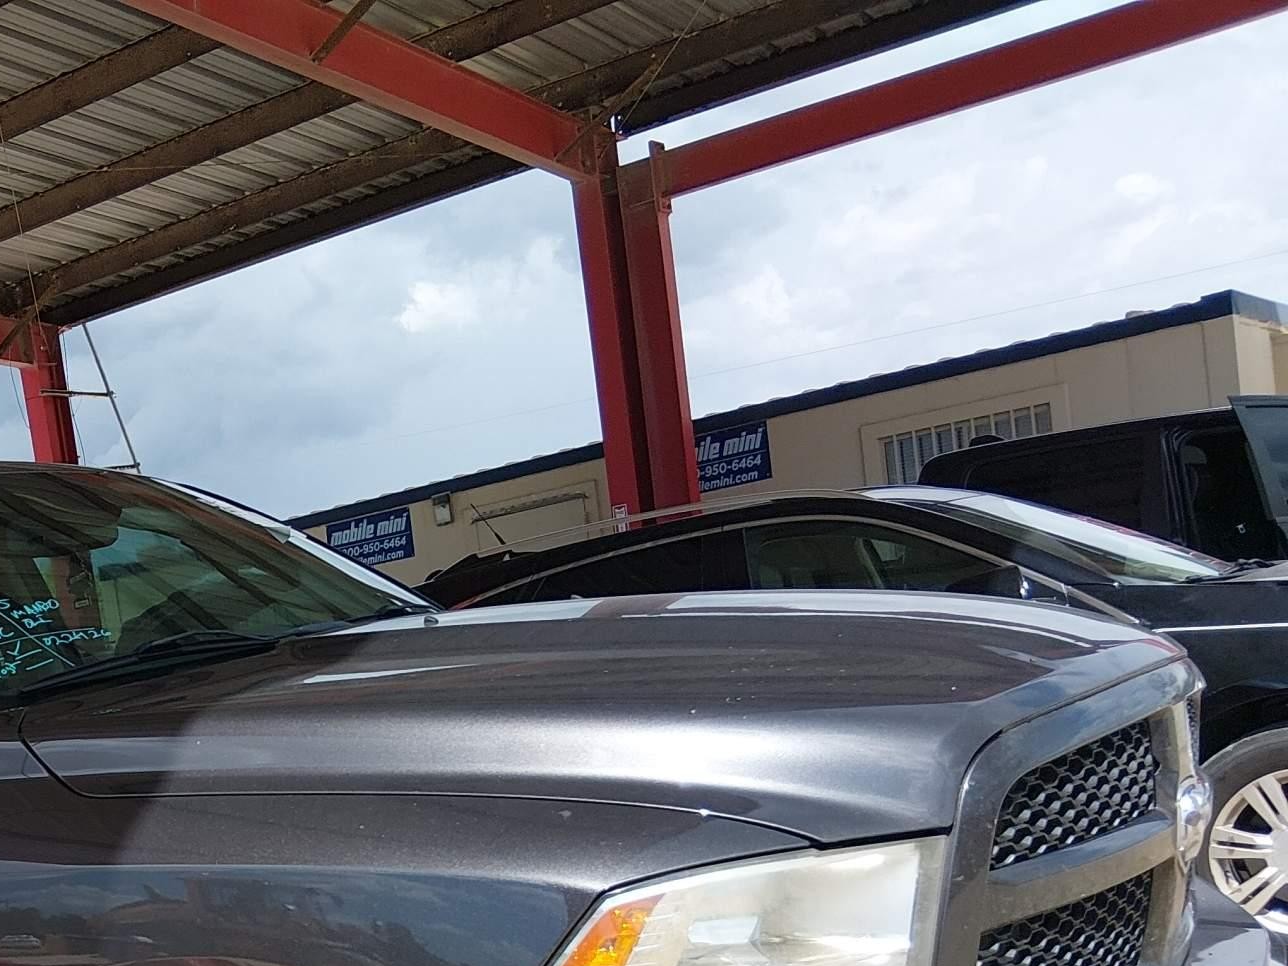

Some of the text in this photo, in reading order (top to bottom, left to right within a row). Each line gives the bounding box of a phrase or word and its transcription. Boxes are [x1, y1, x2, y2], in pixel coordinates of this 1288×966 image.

[723, 428, 763, 456] mini
[330, 512, 408, 546] mobile mini
